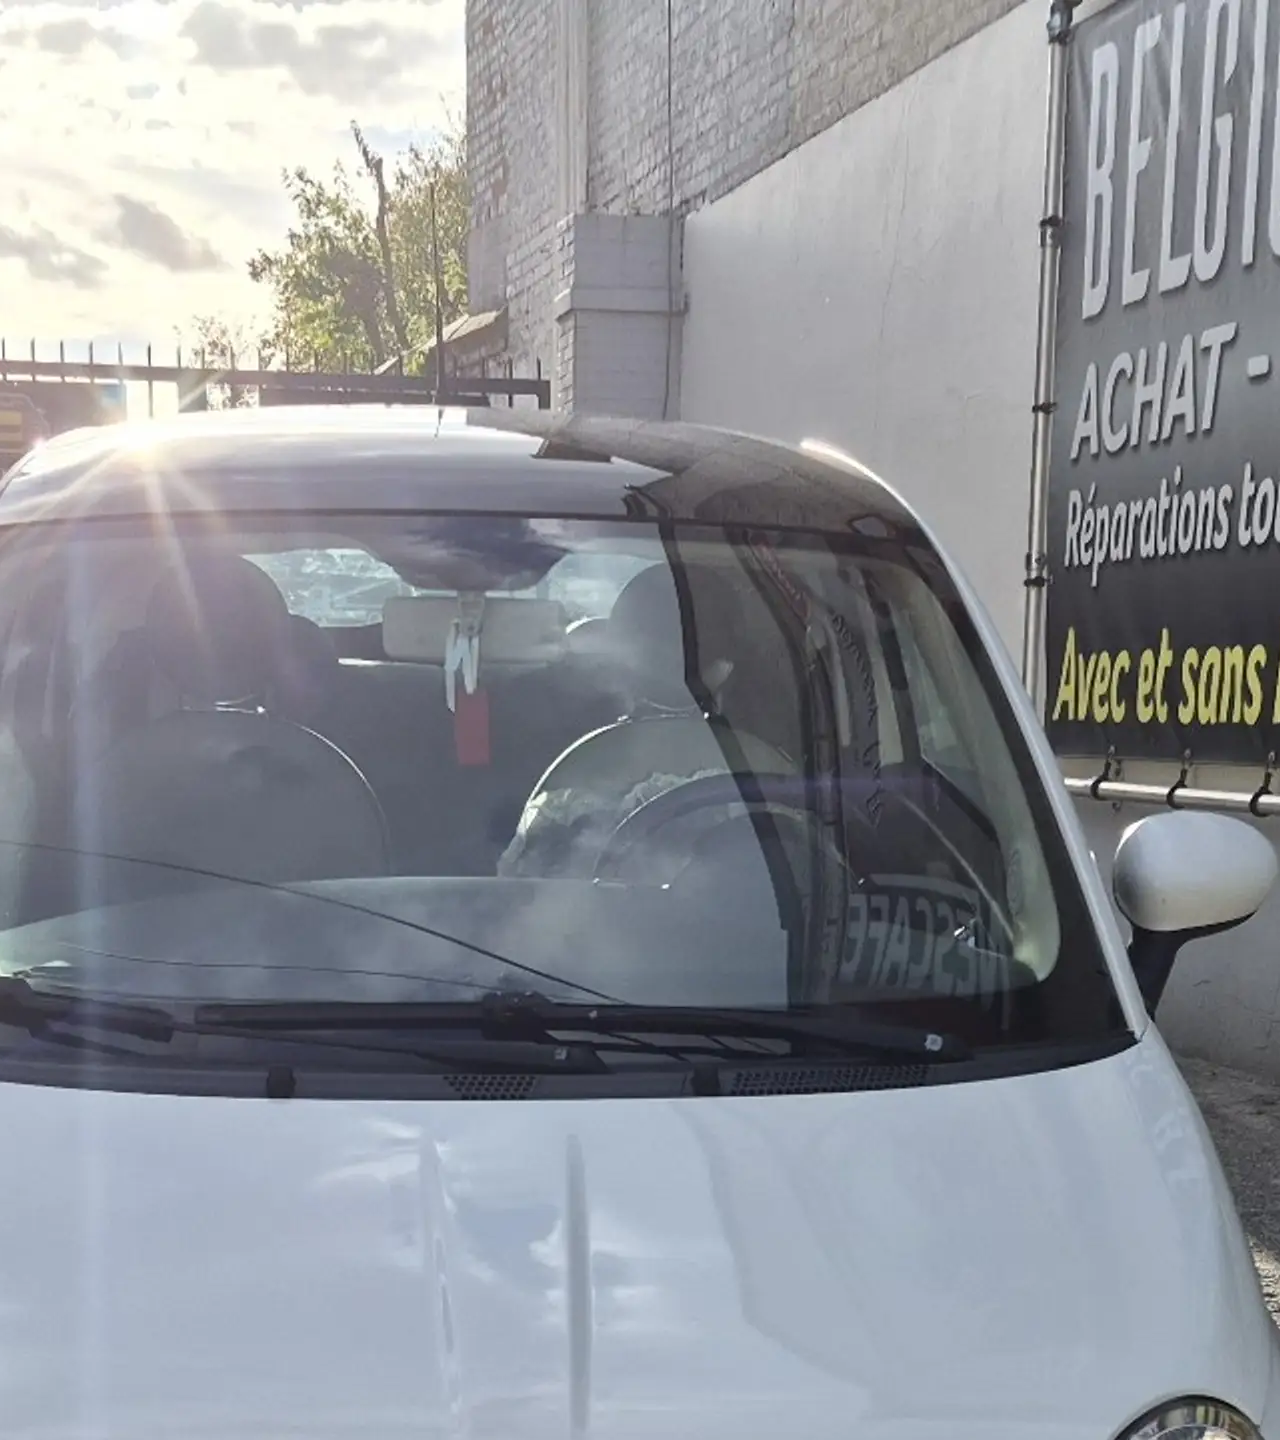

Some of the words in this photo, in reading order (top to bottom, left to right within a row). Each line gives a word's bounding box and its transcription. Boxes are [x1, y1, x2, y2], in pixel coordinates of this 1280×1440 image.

[1070, 322, 1237, 461] ACHAT
[1064, 466, 1233, 588] Réparations
[1052, 626, 1130, 724] Avec
[1136, 628, 1173, 724] et
[1178, 643, 1267, 725] sans
